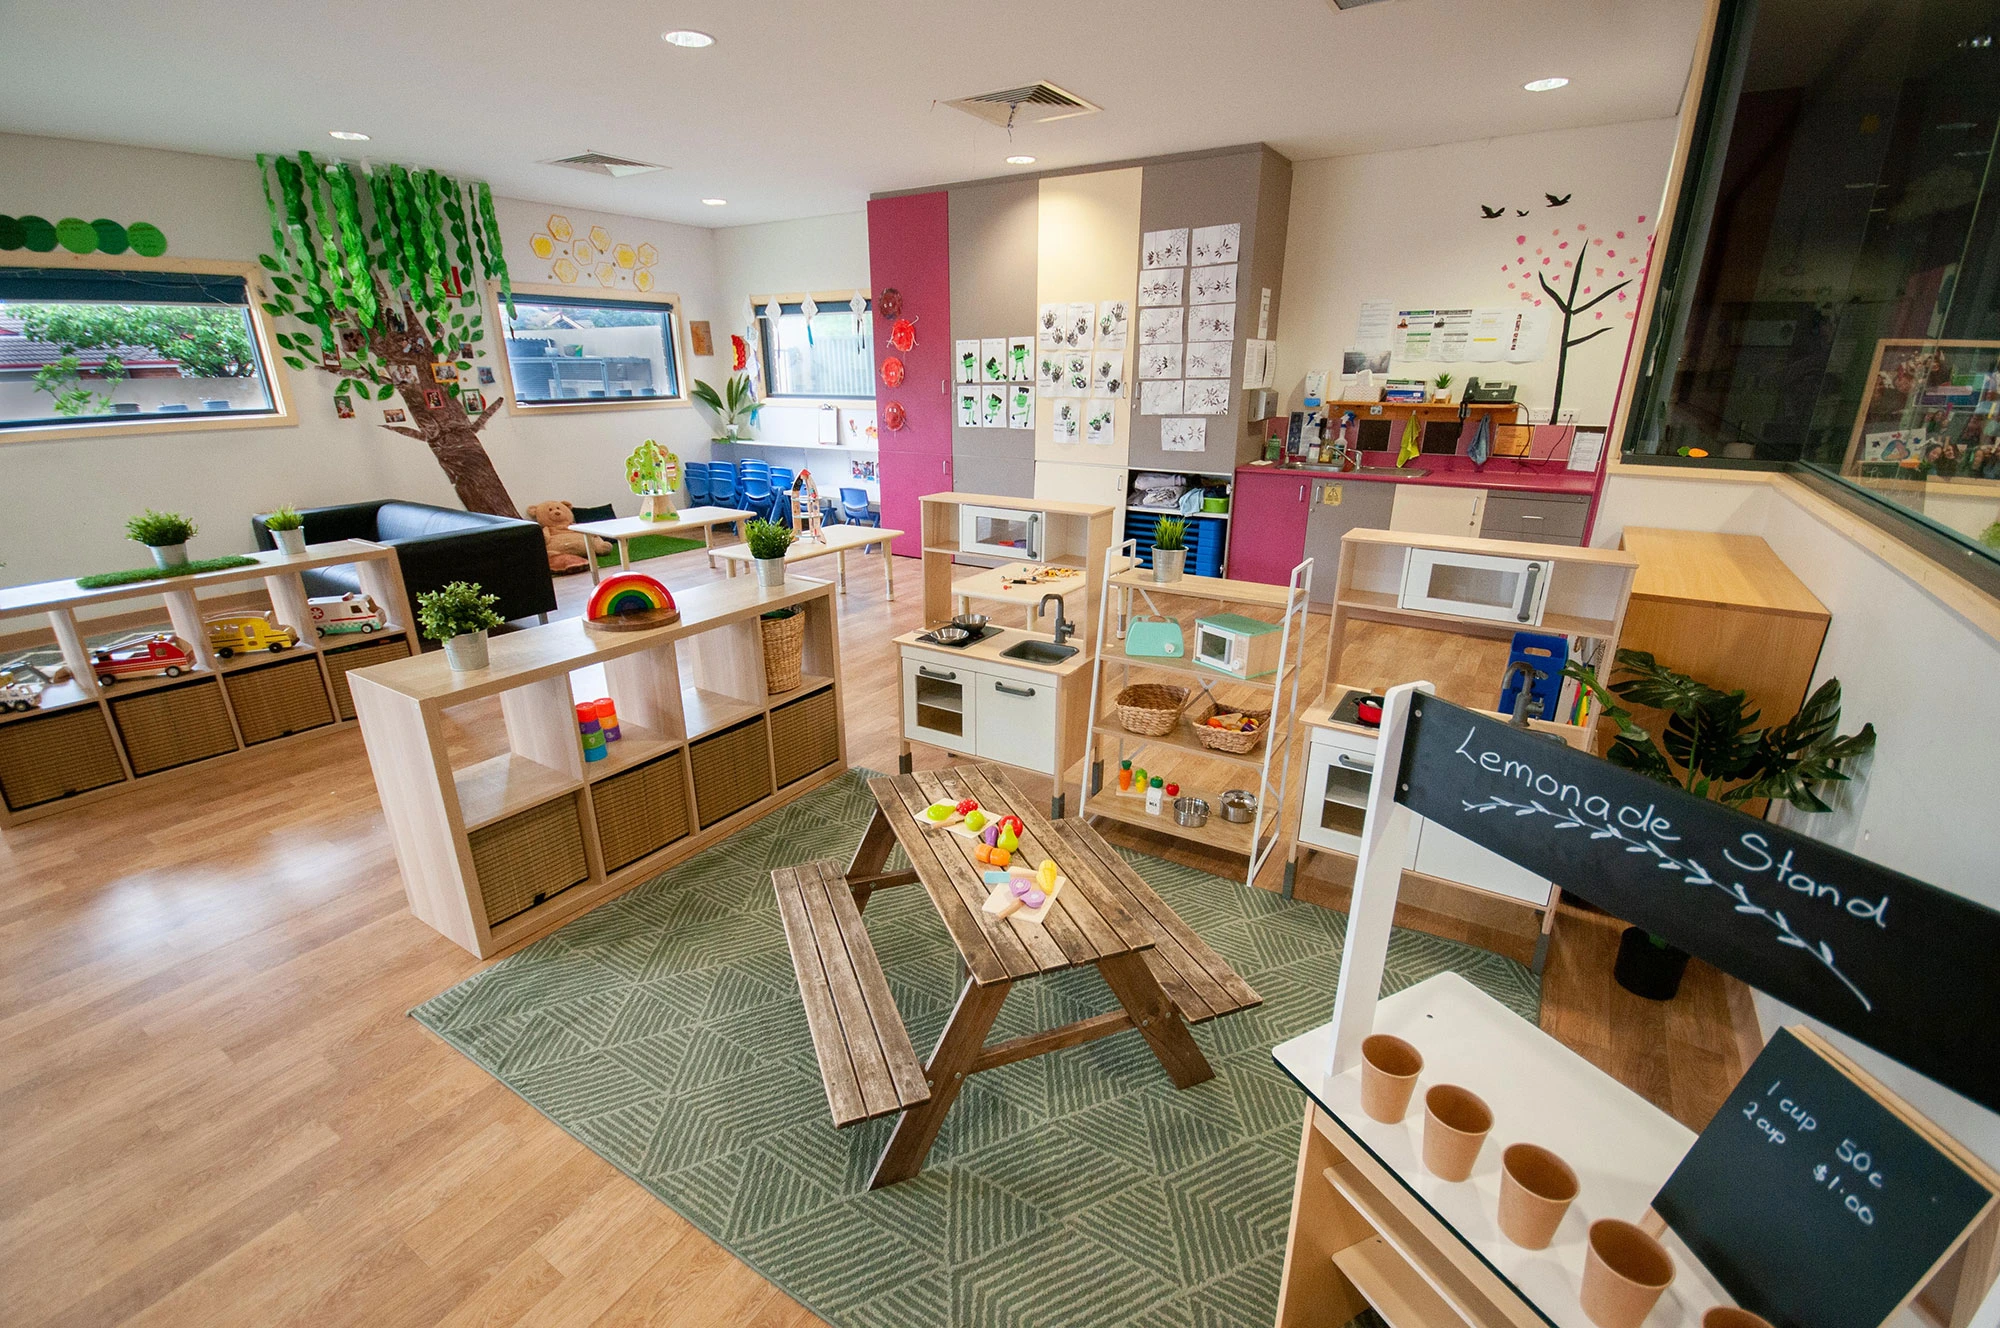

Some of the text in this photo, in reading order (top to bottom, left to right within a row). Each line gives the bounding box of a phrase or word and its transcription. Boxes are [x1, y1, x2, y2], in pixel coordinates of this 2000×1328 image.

[1456, 726, 1889, 929] Lemonade Stand
[1742, 1101, 1875, 1226] 2 cup $1.00
[1767, 1081, 1781, 1096] 1
[1779, 1098, 1817, 1132] cup
